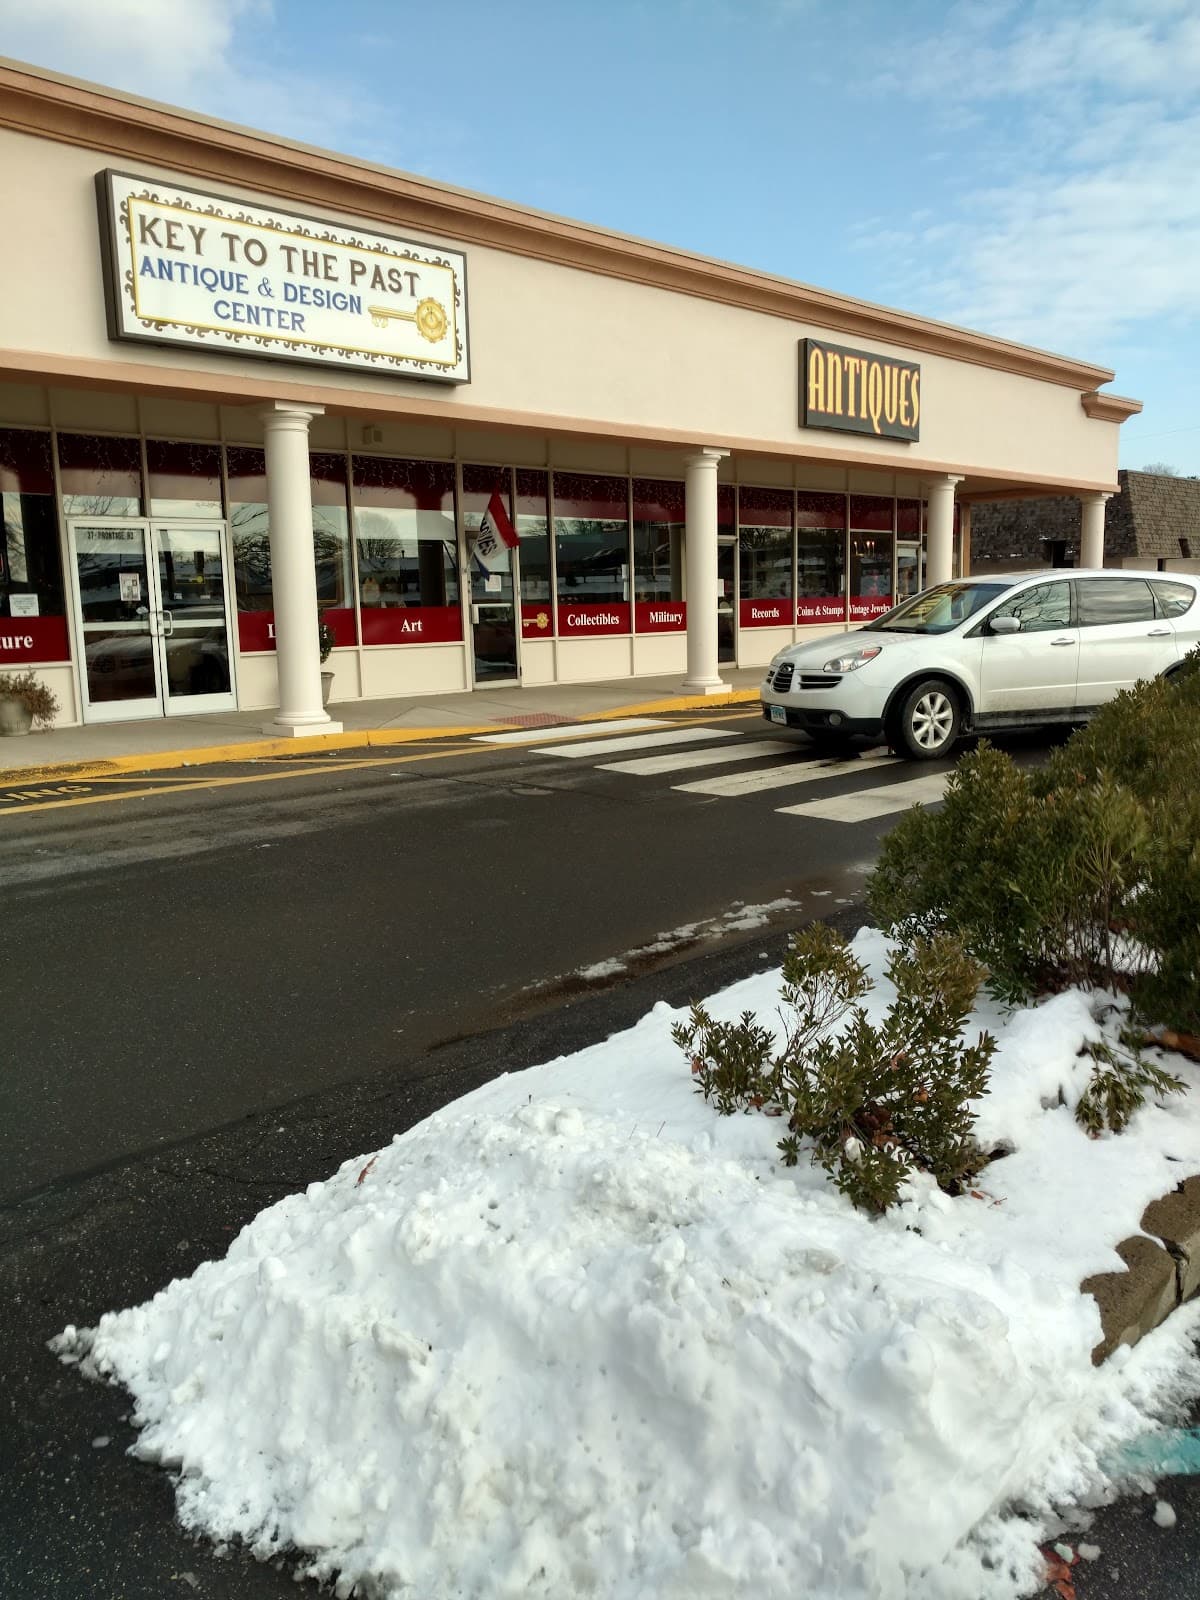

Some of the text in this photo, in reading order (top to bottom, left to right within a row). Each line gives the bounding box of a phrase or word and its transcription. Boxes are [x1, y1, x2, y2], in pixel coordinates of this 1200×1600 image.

[138, 213, 421, 297] KEY TO THE PAST
[139, 255, 362, 315] ANTIQUE & DESIGN
[213, 299, 306, 333] CENTER
[808, 347, 919, 435] ANTIQUES
[649, 611, 683, 625] Military
[751, 607, 780, 619] Records
[797, 605, 844, 617] Coins & Stamps
[400, 618, 423, 632] Art
[567, 612, 620, 627] Collectibles
[0, 785, 92, 801] ING
